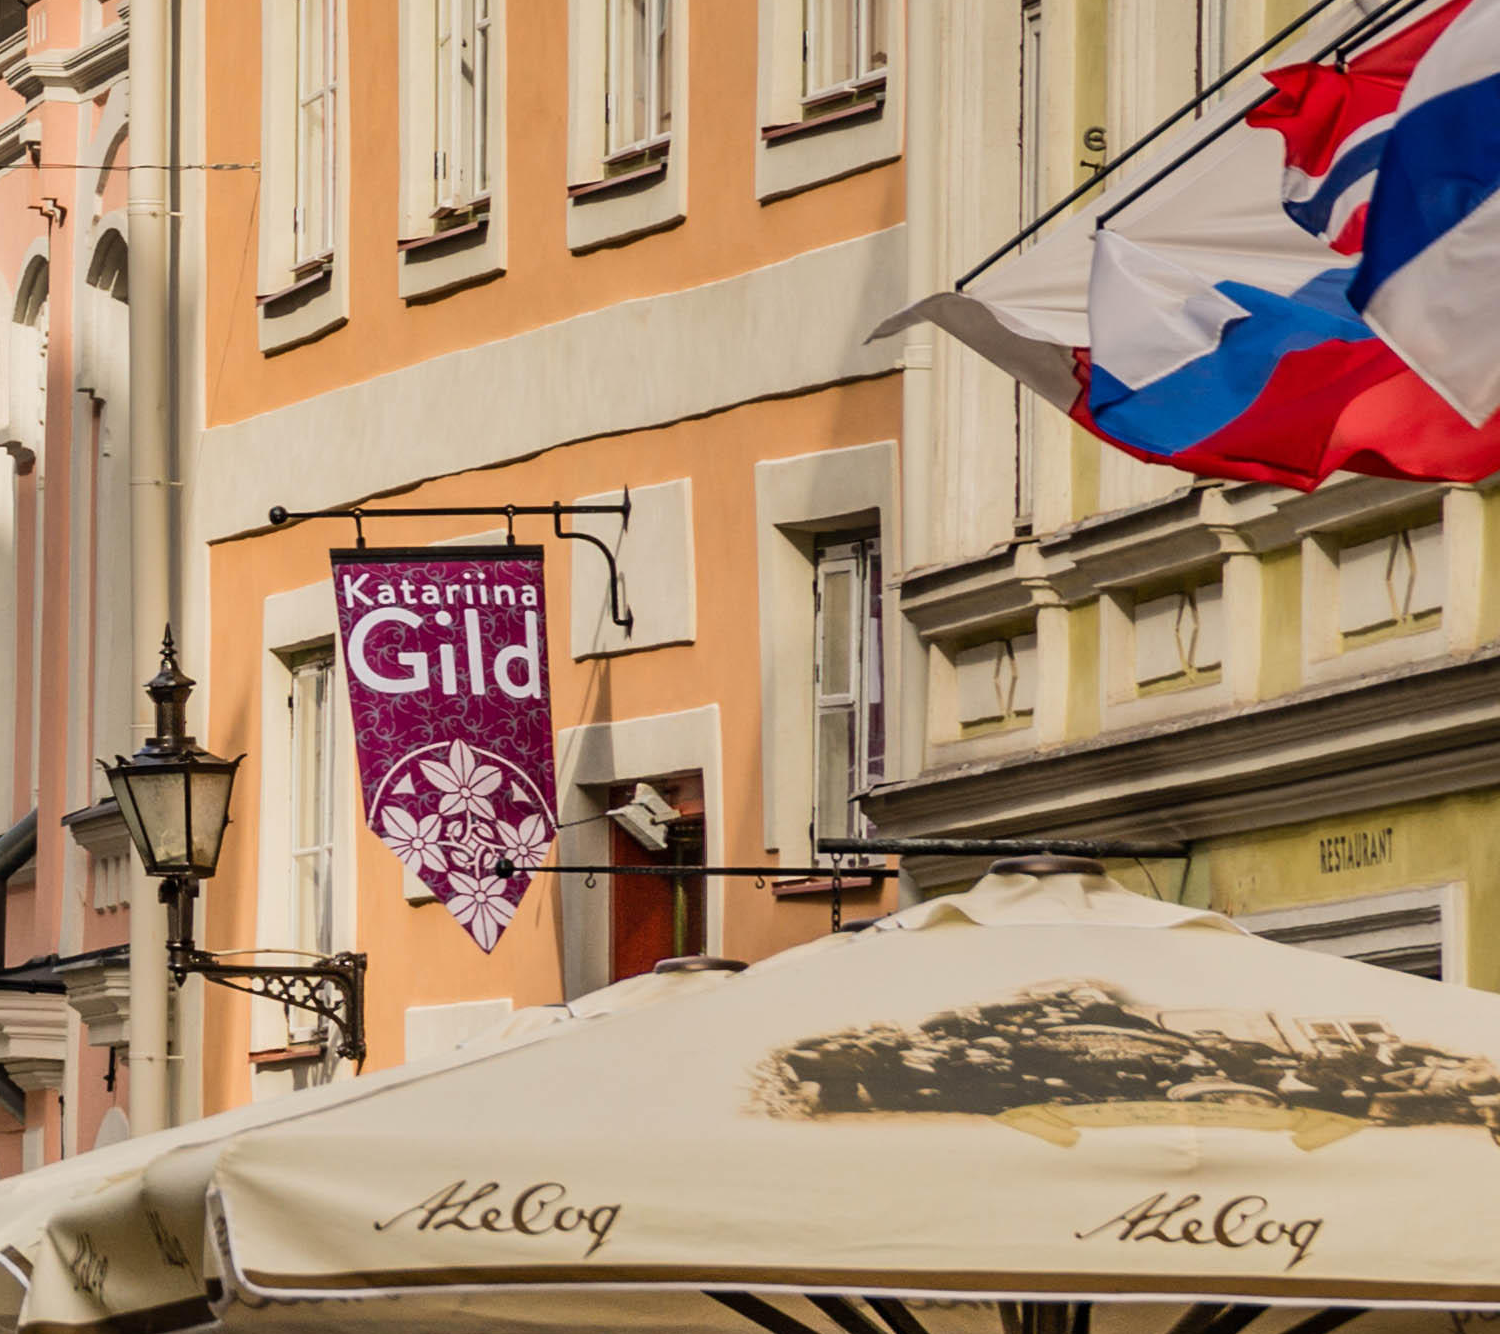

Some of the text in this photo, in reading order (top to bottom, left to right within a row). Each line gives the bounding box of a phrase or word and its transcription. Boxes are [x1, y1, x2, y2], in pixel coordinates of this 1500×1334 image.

[343, 572, 538, 609] Katariina
[348, 607, 541, 699] Gild
[1320, 828, 1392, 874] RESTAURANT
